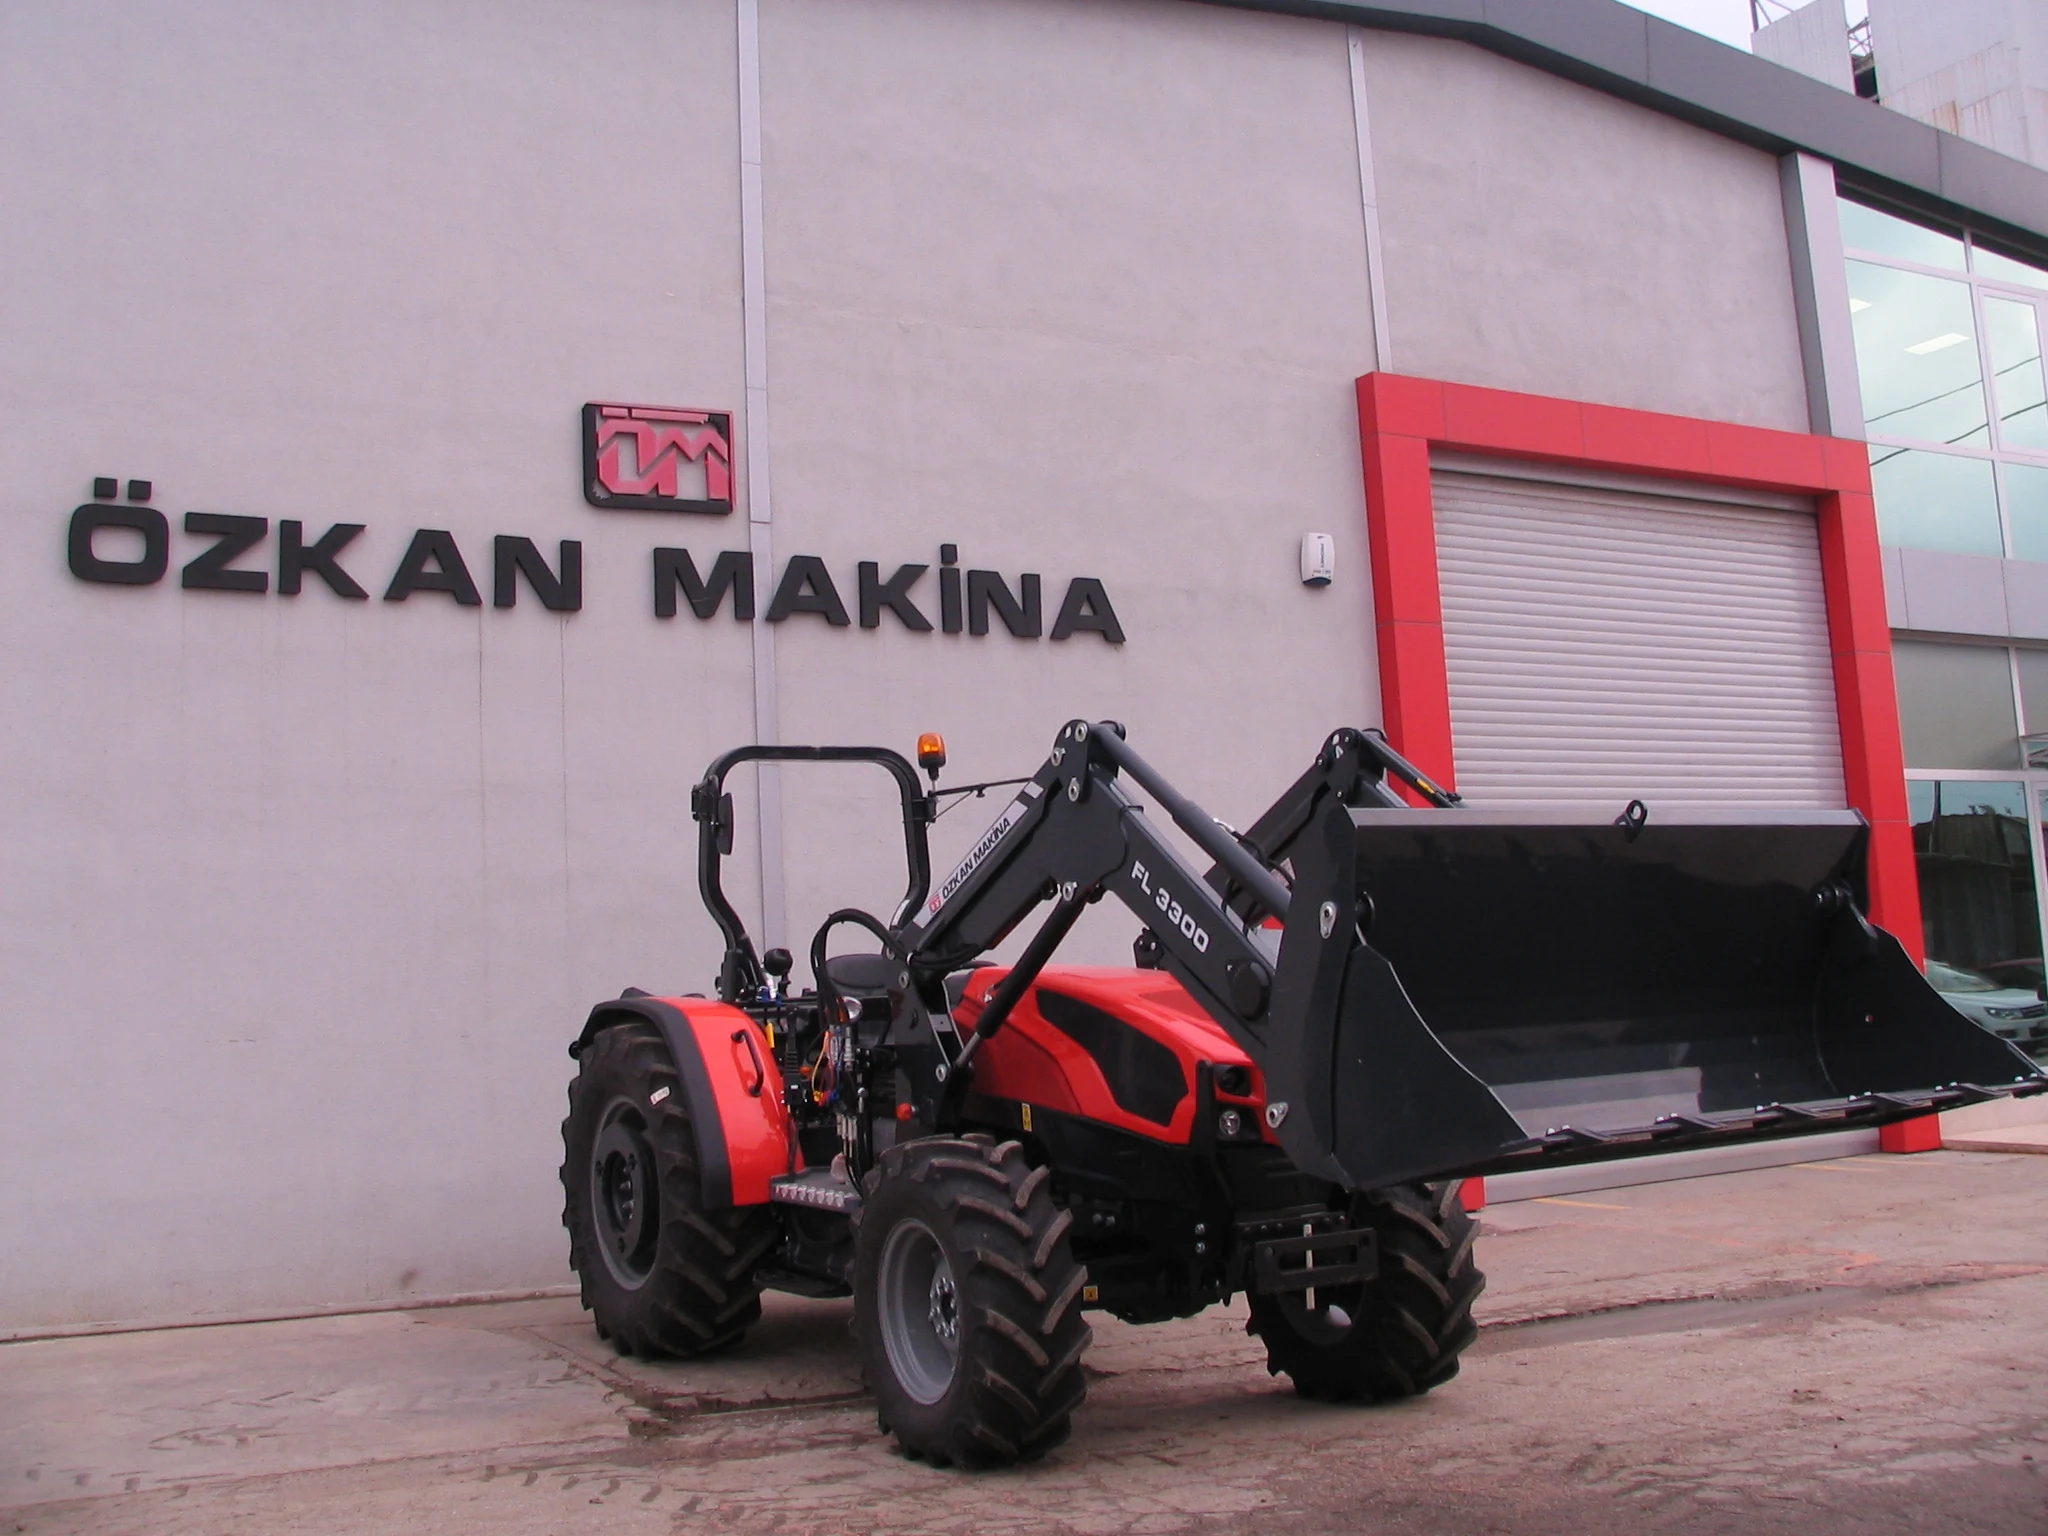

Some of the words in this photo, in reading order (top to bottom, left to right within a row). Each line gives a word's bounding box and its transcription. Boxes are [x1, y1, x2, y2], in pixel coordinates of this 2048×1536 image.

[67, 477, 583, 612] ÖZKAN
[653, 543, 1127, 643] MAKİNA
[1131, 860, 1152, 896] FL
[1155, 887, 1210, 953] 3300
